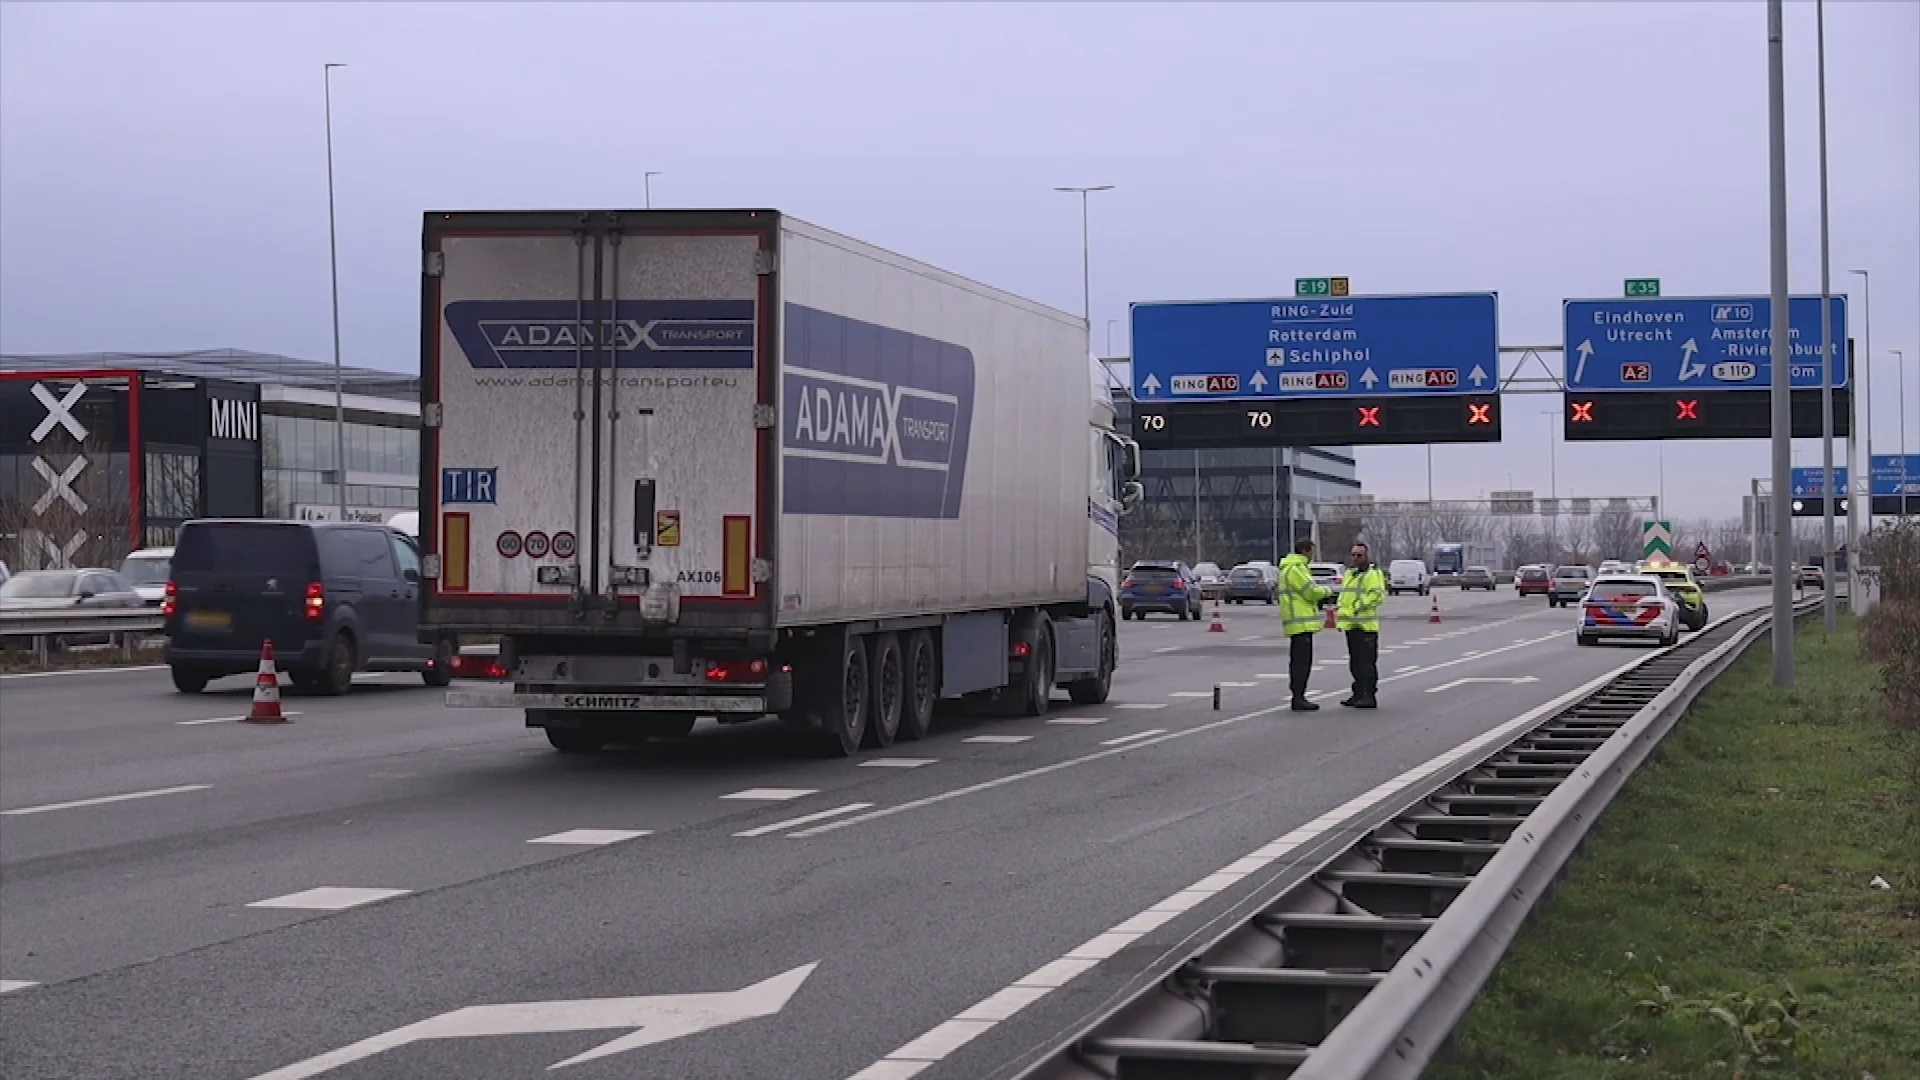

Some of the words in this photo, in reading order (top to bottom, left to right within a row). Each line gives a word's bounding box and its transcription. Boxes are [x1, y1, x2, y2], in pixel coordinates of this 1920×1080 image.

[1594, 310, 1684, 324] Eindhoven
[660, 329, 743, 340] TRANSPORT
[1269, 328, 1357, 342] Rotterdam
[1607, 328, 1672, 342] Utrecht
[1711, 328, 1800, 340] Amsterm
[1290, 348, 1370, 364] Schiphol
[1391, 374, 1423, 384] RING
[1428, 371, 1456, 384] A10
[1625, 367, 1647, 379] A2
[1173, 379, 1205, 389] RING
[1209, 377, 1237, 389] A10
[1282, 376, 1313, 386] RING
[1318, 374, 1346, 386] A10
[212, 398, 257, 440] MINI
[796, 384, 902, 466] ADAMAX
[903, 417, 949, 442] TRANSPORT
[1142, 416, 1165, 430] 70
[1248, 412, 1272, 427] 70
[447, 470, 493, 501] TIR
[530, 538, 545, 550] 70
[677, 570, 721, 583] AX106
[564, 696, 640, 708] SCHMITZ
